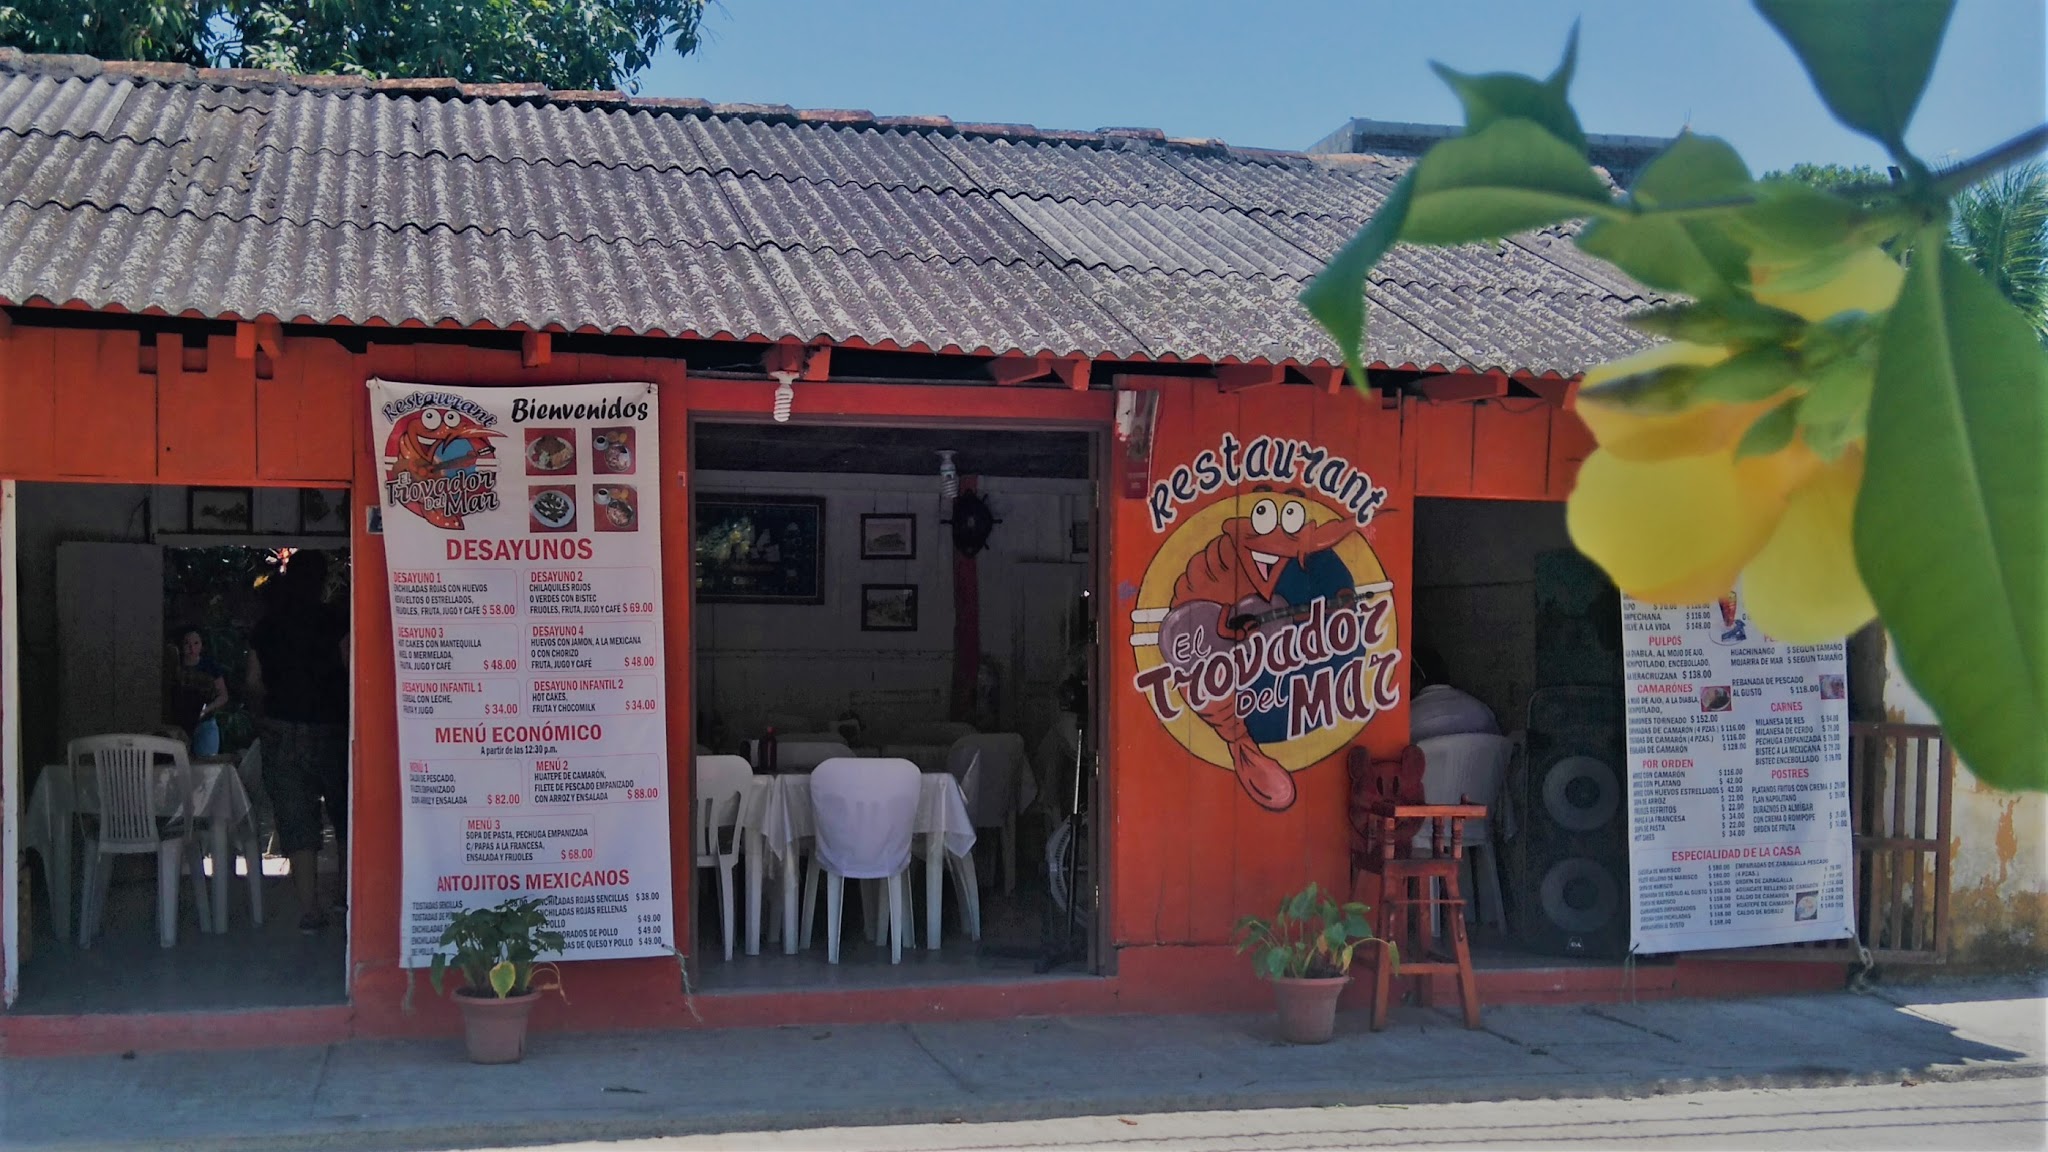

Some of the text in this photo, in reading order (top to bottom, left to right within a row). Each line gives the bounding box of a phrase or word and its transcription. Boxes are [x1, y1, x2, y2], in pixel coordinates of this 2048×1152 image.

[383, 392, 497, 427] Restaurant
[511, 396, 648, 423] Bienvenidos
[386, 470, 495, 506] Trovador
[445, 491, 500, 516] Mar
[446, 538, 593, 561] DESAYUNOS
[531, 571, 583, 583] DESAYUNO 2
[448, 584, 488, 593] CON HUEVOS
[529, 583, 591, 593] CHILAQUILES ROJOS
[535, 594, 597, 603] VERDES CON BISTEC
[490, 604, 515, 615] 58.00
[629, 602, 653, 613] 69.00
[439, 627, 444, 638] 3
[532, 625, 584, 638] DESAYUNO 4
[425, 639, 439, 648] CON
[440, 639, 482, 649] MANTEQUILLA
[530, 636, 642, 647] HUEVOS CON LA MEXICANA
[1172, 624, 1212, 662] El
[1648, 635, 1682, 646] PULPOS
[413, 651, 453, 660] MERMELADA,
[537, 649, 579, 658] CON CHORIZO
[1134, 596, 1391, 721] Trovador
[414, 662, 430, 670] JUGO
[491, 660, 517, 670] 48.00
[531, 656, 655, 669] FRUTA, JUGO 48.00
[1689, 669, 1712, 679] 138.00
[534, 679, 624, 691] DESAYUNO INFANTIL 2
[1732, 676, 1804, 687] REBANADA DE PESCADO
[440, 682, 483, 693] INFANTIL 1
[1637, 684, 1693, 694] CAMARÓNES
[1732, 685, 1819, 697] AL GUSTO 118.00
[416, 695, 430, 704] CON
[430, 695, 453, 704] LECHE,
[532, 692, 568, 702] HOT CAKES,
[1236, 674, 1290, 719] Del
[492, 703, 518, 714] 34.00
[532, 699, 656, 713] FRUTA CHOCOMILK 34.00
[1770, 701, 1803, 712] CARNES
[1697, 714, 1718, 723] 152.00
[1755, 718, 1784, 726] MILANESA
[1793, 716, 1805, 725] RES
[435, 720, 602, 743] MENÚ ECONÓMICO
[1755, 727, 1785, 736] MILANESA
[1755, 735, 1822, 746] PECHUGA EMPANIZADA
[486, 744, 558, 757] partir de las 12:30 p.m.
[1755, 747, 1776, 756] BISTEC
[1789, 745, 1822, 754] MEXICANA
[536, 758, 569, 771] MENÚ 2
[1643, 759, 1694, 769] POR ORDEN
[1755, 755, 1820, 766] BISTEC ENCEBOLLADO
[534, 769, 607, 781] HUATEPE DE CAMARÓN,
[1771, 768, 1810, 779] POSTRES
[534, 780, 635, 792] FILETE DE PESCADO EMPANIZADO
[1726, 777, 1743, 785] 42.00
[435, 796, 468, 805] ENSALADA
[495, 794, 520, 804] 82.00
[534, 788, 658, 803] CON ARROZ ENSALADA 88.00
[467, 817, 501, 830] MENÚ 3
[1655, 815, 1686, 823] FRANCESA
[466, 828, 589, 841] SOPA DE PASTA, PECHUGA EMPANIZADA
[501, 841, 545, 851] LA FRANCESA,
[466, 849, 593, 862] ENSALADA 68.00
[1672, 845, 1802, 861] ESPECIALIDAD DE LA CASA
[437, 869, 630, 892] ANTOJITOS MEXICANOS
[575, 892, 660, 904] ROJAS SENCILLAS 38.00
[575, 904, 628, 915] ROJAS RELLENAS
[643, 913, 661, 922] 49.00
[589, 925, 661, 937] DE POLLO 49.00
[576, 940, 585, 949] DE
[586, 939, 608, 949] QUESO
[613, 938, 634, 948] POLLO
[644, 936, 662, 946] 49.00
